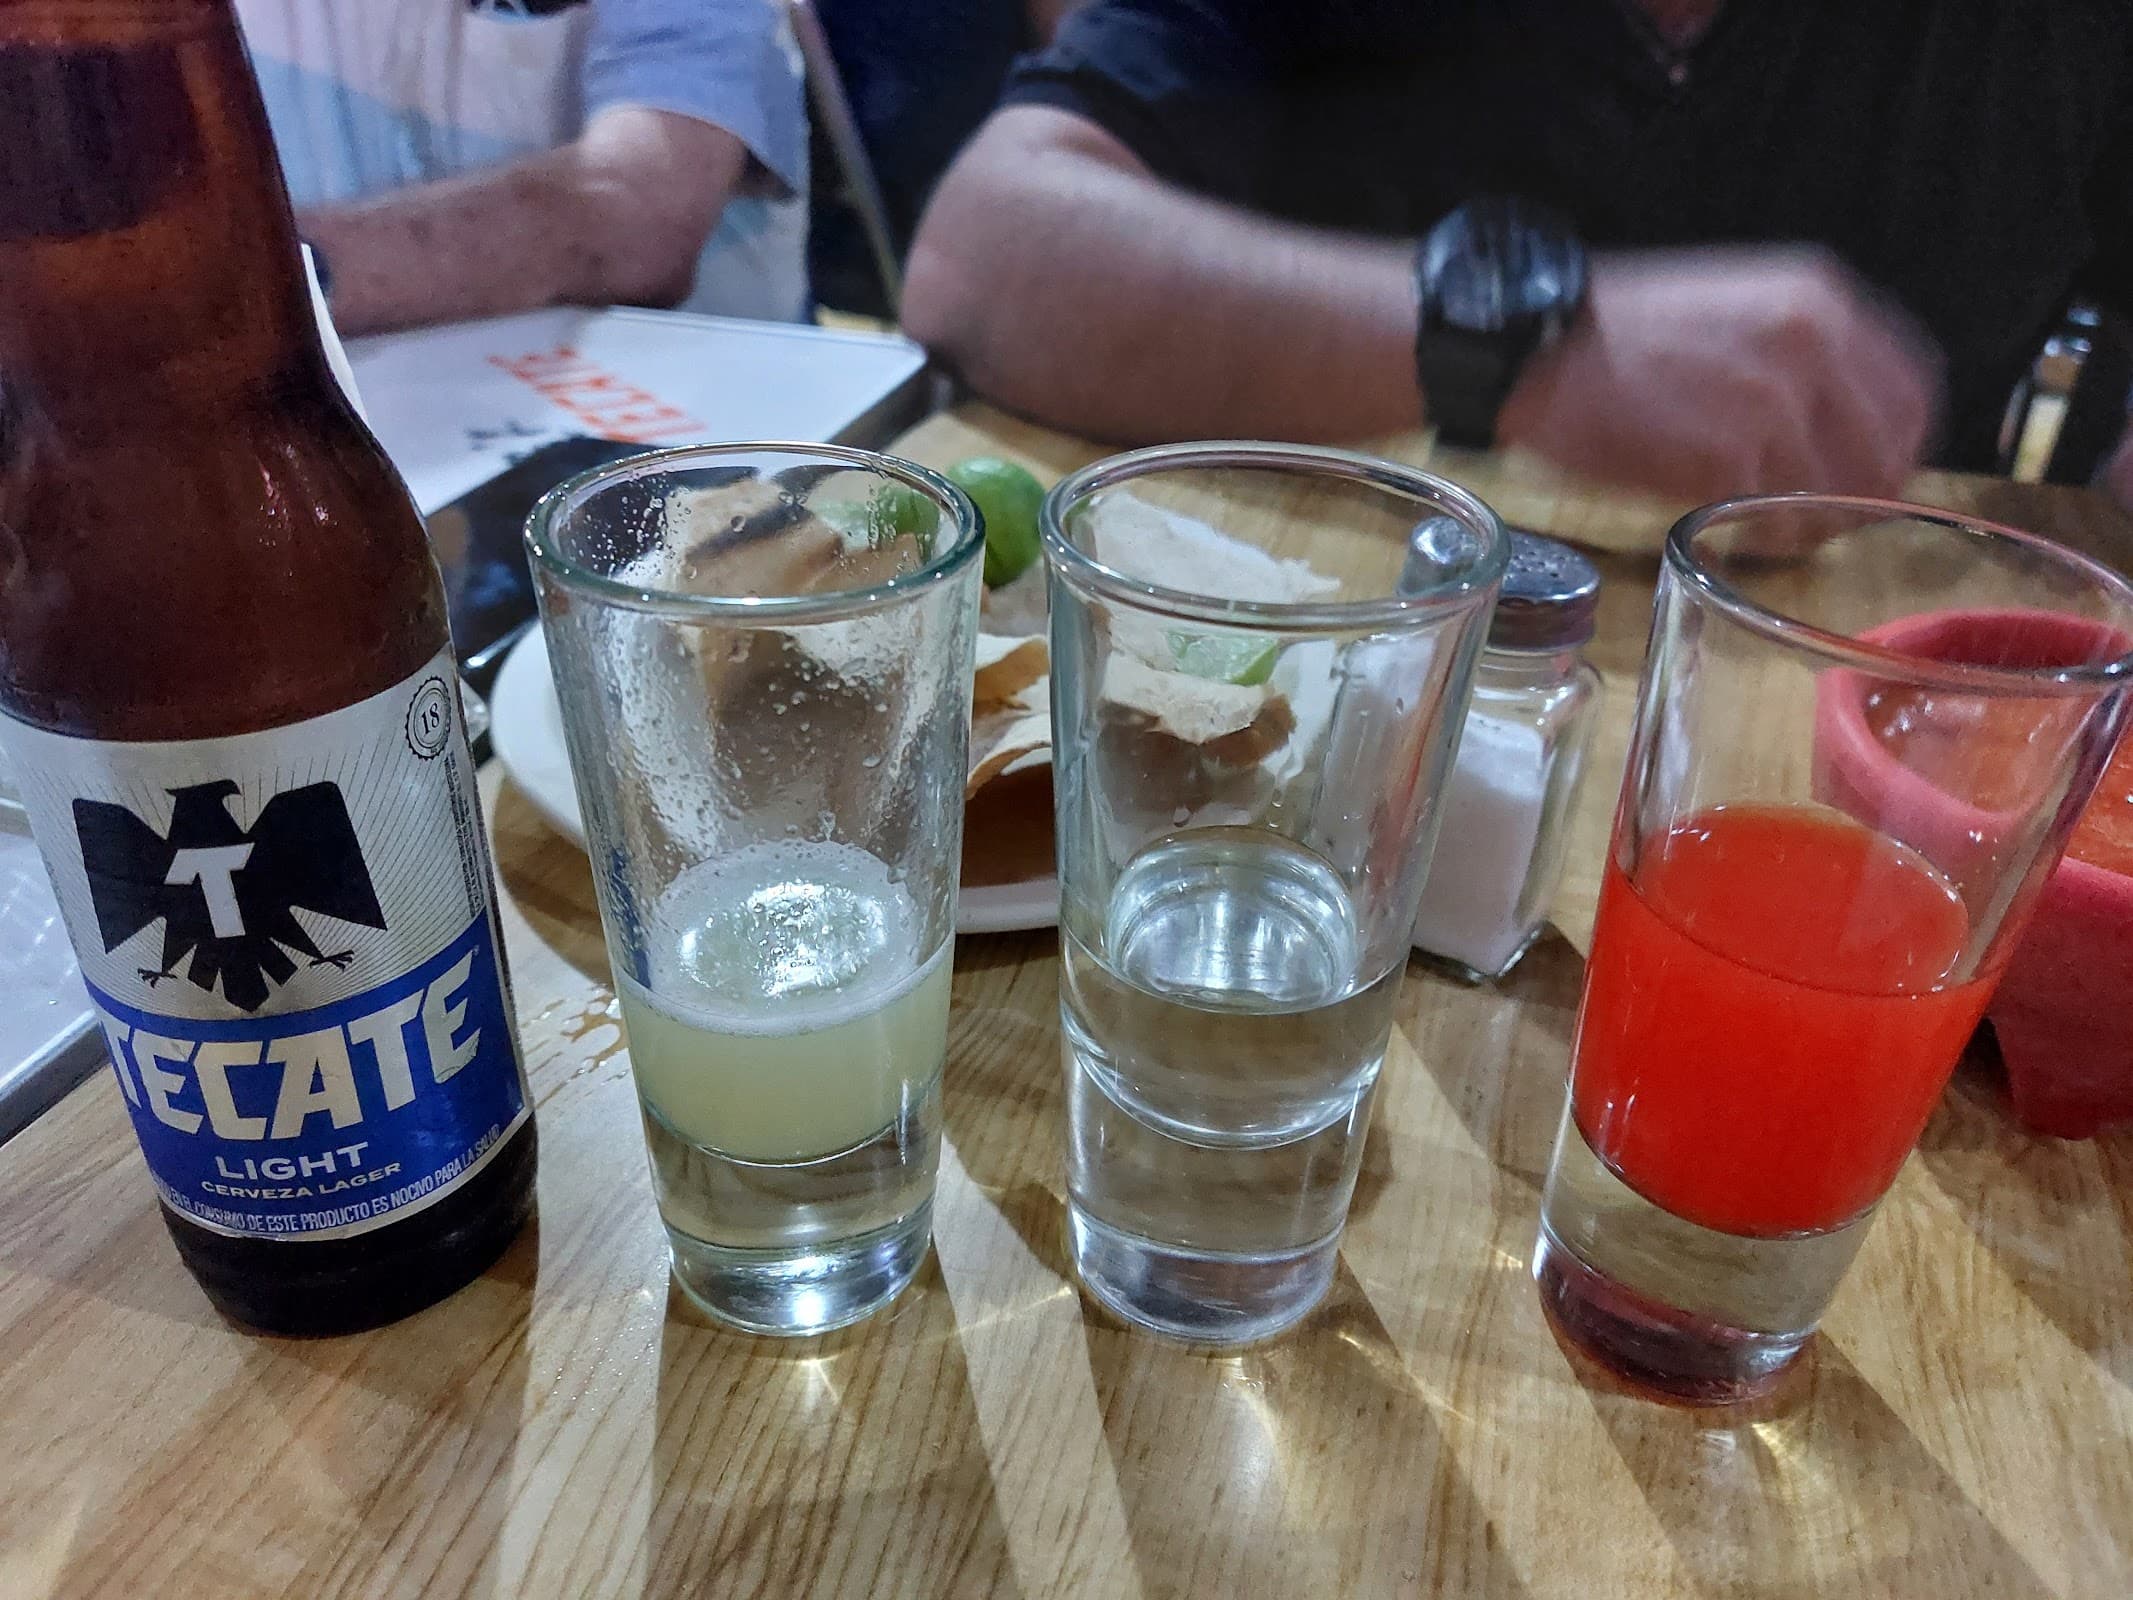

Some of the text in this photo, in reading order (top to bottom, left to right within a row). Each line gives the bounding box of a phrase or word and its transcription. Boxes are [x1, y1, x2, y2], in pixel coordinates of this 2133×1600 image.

[421, 702, 440, 734] 18
[164, 842, 254, 938] T
[106, 951, 481, 1140] TECATE
[193, 1202, 246, 1230] CONSUMO
[248, 1214, 266, 1232] DE
[266, 1214, 299, 1233] ESTE
[300, 1201, 371, 1231] PRODUCTO
[372, 1195, 390, 1216] ES
[391, 1175, 435, 1210] NOCIVO
[434, 1157, 463, 1187] PARA
[459, 1149, 476, 1170] LA
[201, 1180, 314, 1199] CERVEZA
[317, 1161, 402, 1195] LAGER
[215, 1141, 369, 1180] LIGHT
